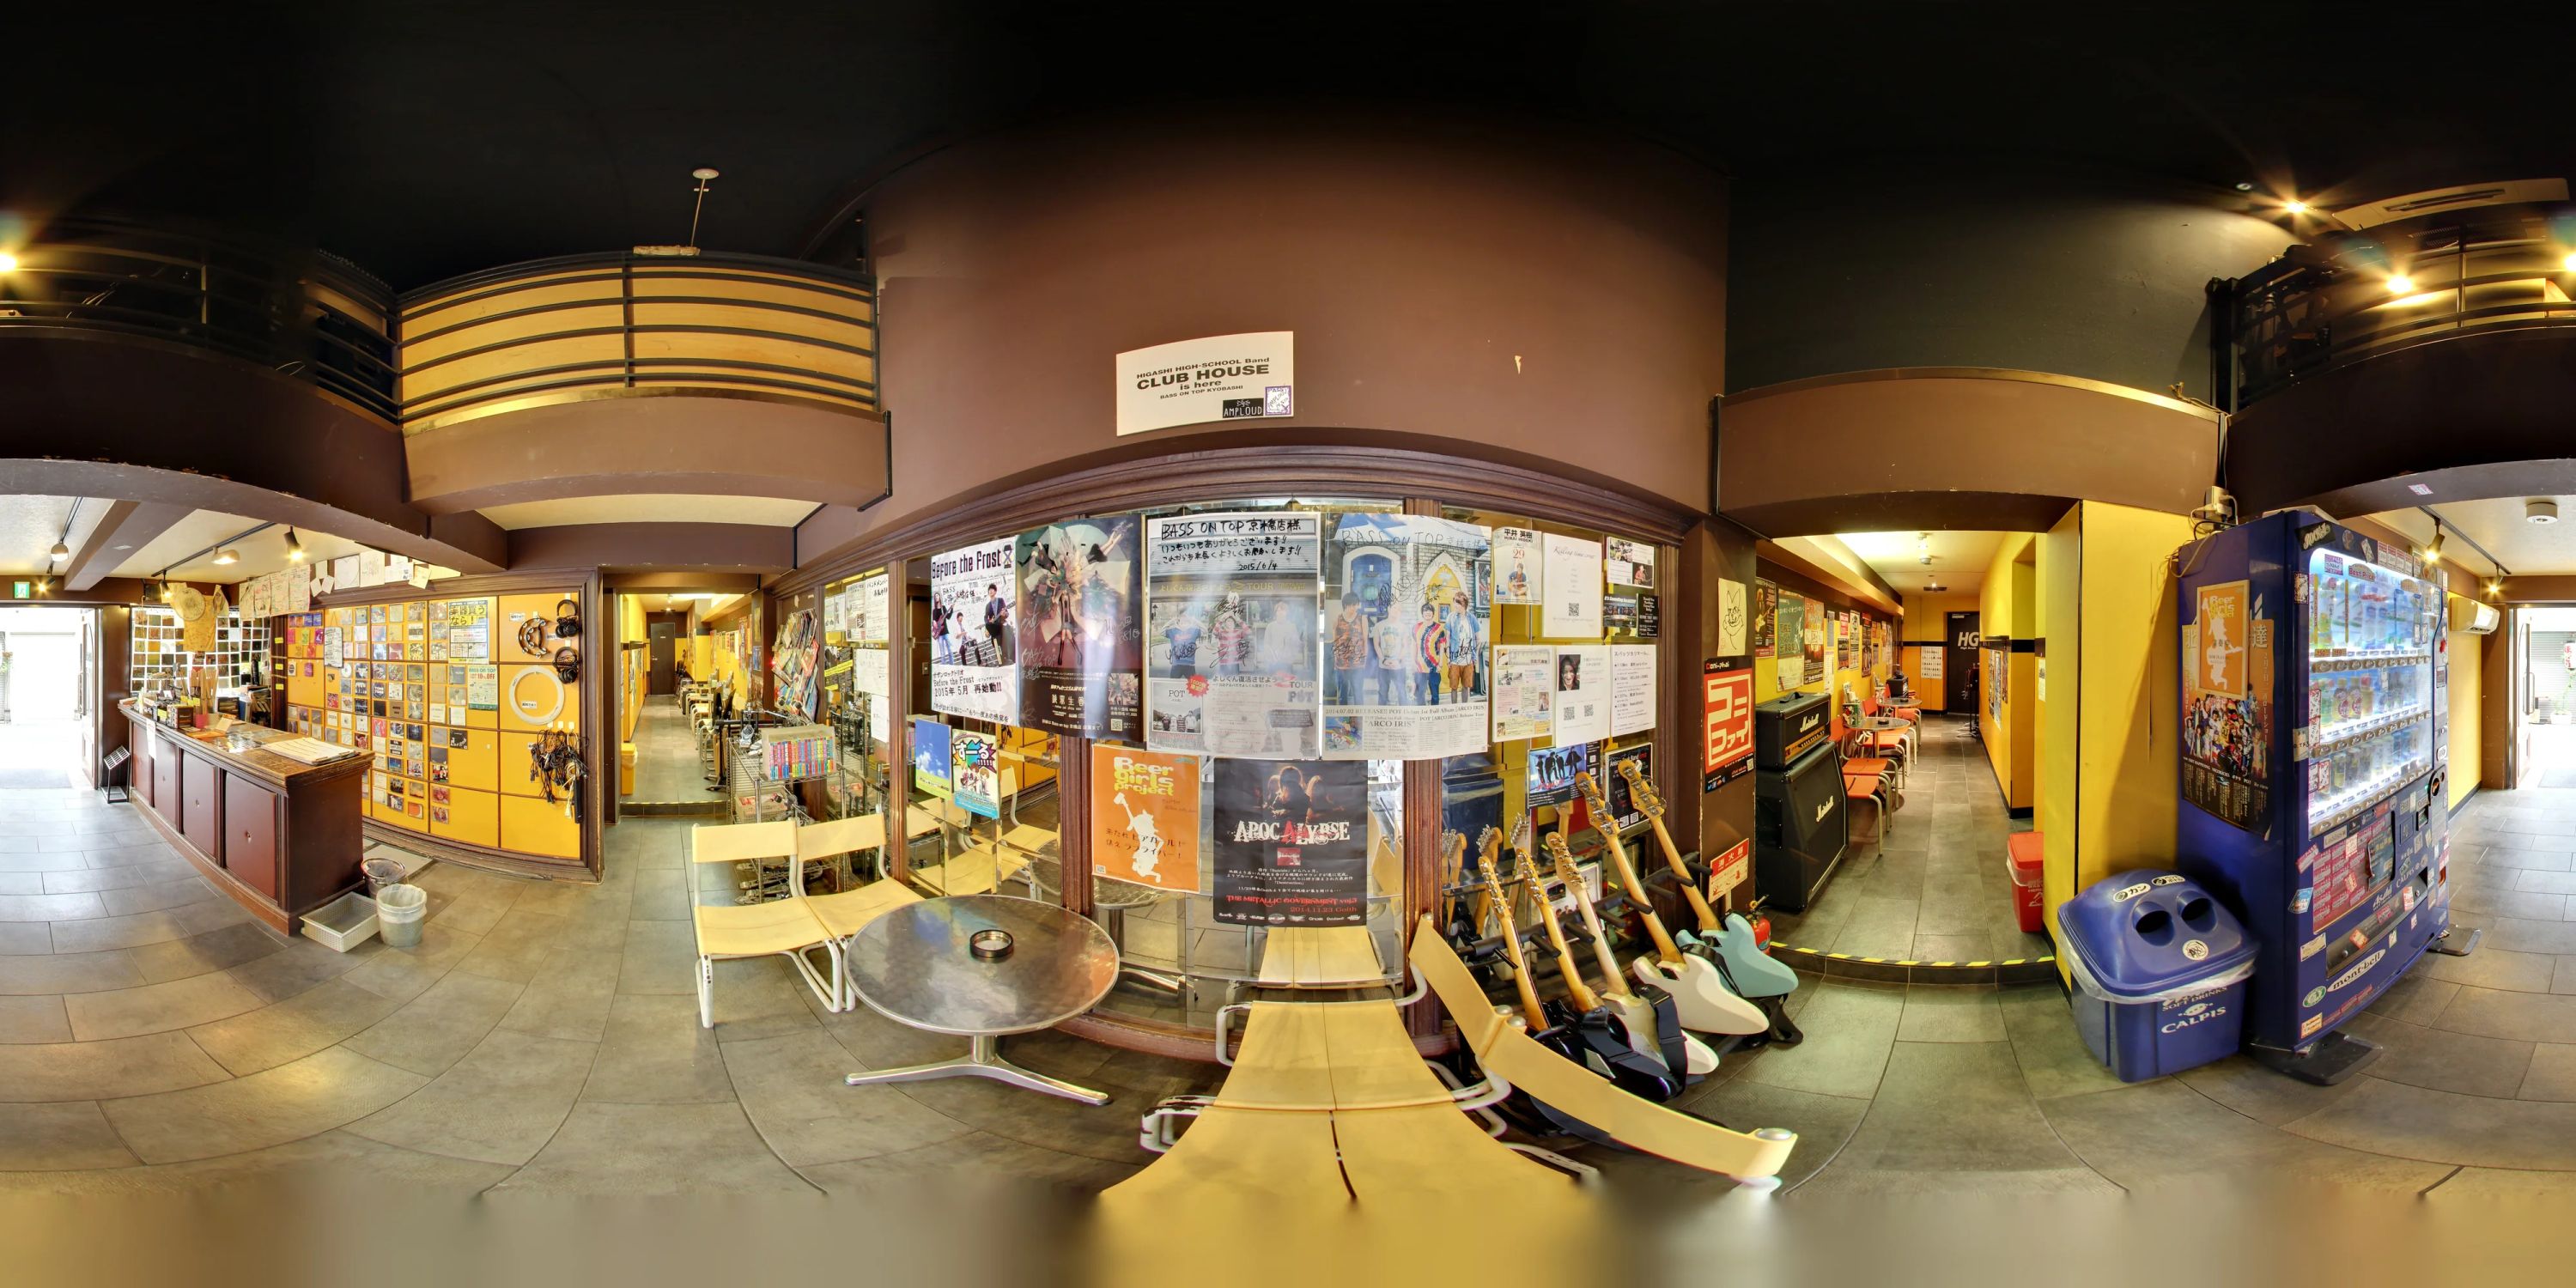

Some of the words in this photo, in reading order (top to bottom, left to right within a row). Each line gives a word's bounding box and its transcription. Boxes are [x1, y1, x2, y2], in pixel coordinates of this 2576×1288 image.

[1137, 368, 1172, 379] HIGASHI
[1176, 359, 1242, 372] HIGH-SCHOOL
[1137, 372, 1189, 390] CLUB
[1197, 364, 1269, 380] HOUSE
[1194, 380, 1222, 388] here
[1224, 406, 1262, 416] AMPLOUD
[1162, 522, 1194, 540] BASS
[1201, 521, 1217, 532] ON
[1220, 520, 1244, 532] TOP
[1341, 530, 1382, 546] BASS
[1415, 532, 1443, 545] TOP
[1504, 528, 1517, 537] 平井
[1513, 550, 1524, 559] 29
[933, 561, 957, 581] Before
[960, 554, 973, 574] the
[976, 549, 1001, 570] Frost
[1958, 632, 1979, 647] HG
[960, 676, 975, 684] Frost
[1168, 690, 1186, 698] POT
[1800, 714, 1820, 732] Marshall
[1113, 756, 1174, 775] Beer
[1114, 769, 1174, 787] girls
[1114, 782, 1174, 796] project
[1816, 795, 1834, 822] Marshall
[1234, 820, 1350, 845] APOCALYPSE
[2129, 885, 2147, 895] カン
[1243, 896, 1282, 907] METALLIC
[1284, 896, 1337, 906] GOVERNMENT
[2333, 952, 2380, 989] mont-bell
[2162, 999, 2188, 1012] SOFT
[2191, 987, 2227, 1002] DRINKS
[2161, 1006, 2227, 1034] CALPIS
